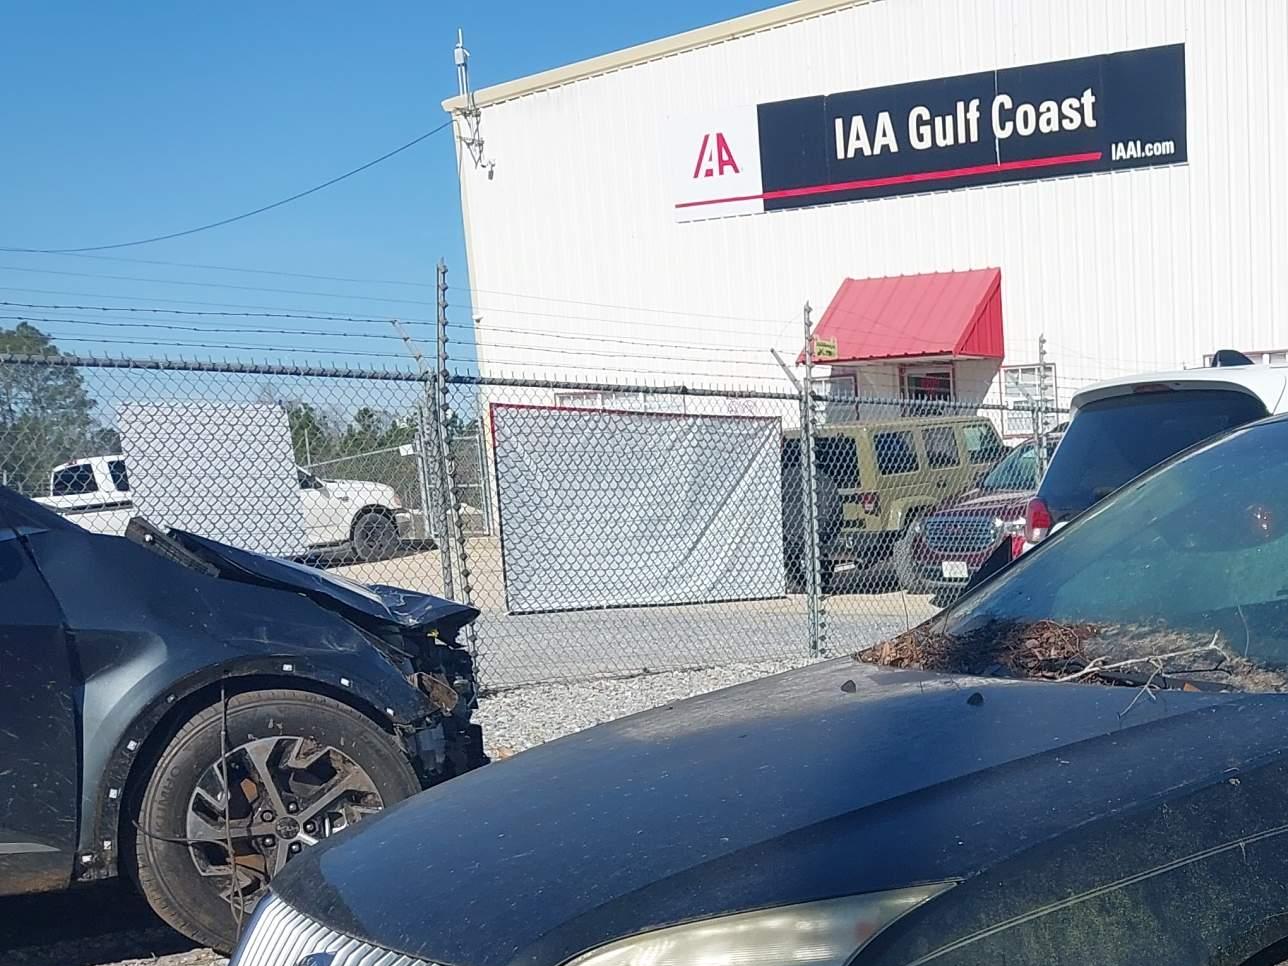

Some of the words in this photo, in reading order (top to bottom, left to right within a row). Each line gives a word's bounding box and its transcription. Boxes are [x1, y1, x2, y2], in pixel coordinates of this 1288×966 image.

[833, 112, 899, 160] IAA
[908, 99, 980, 150] Gulf
[991, 88, 1097, 140] Coast
[1111, 140, 1175, 161] IAAI.com
